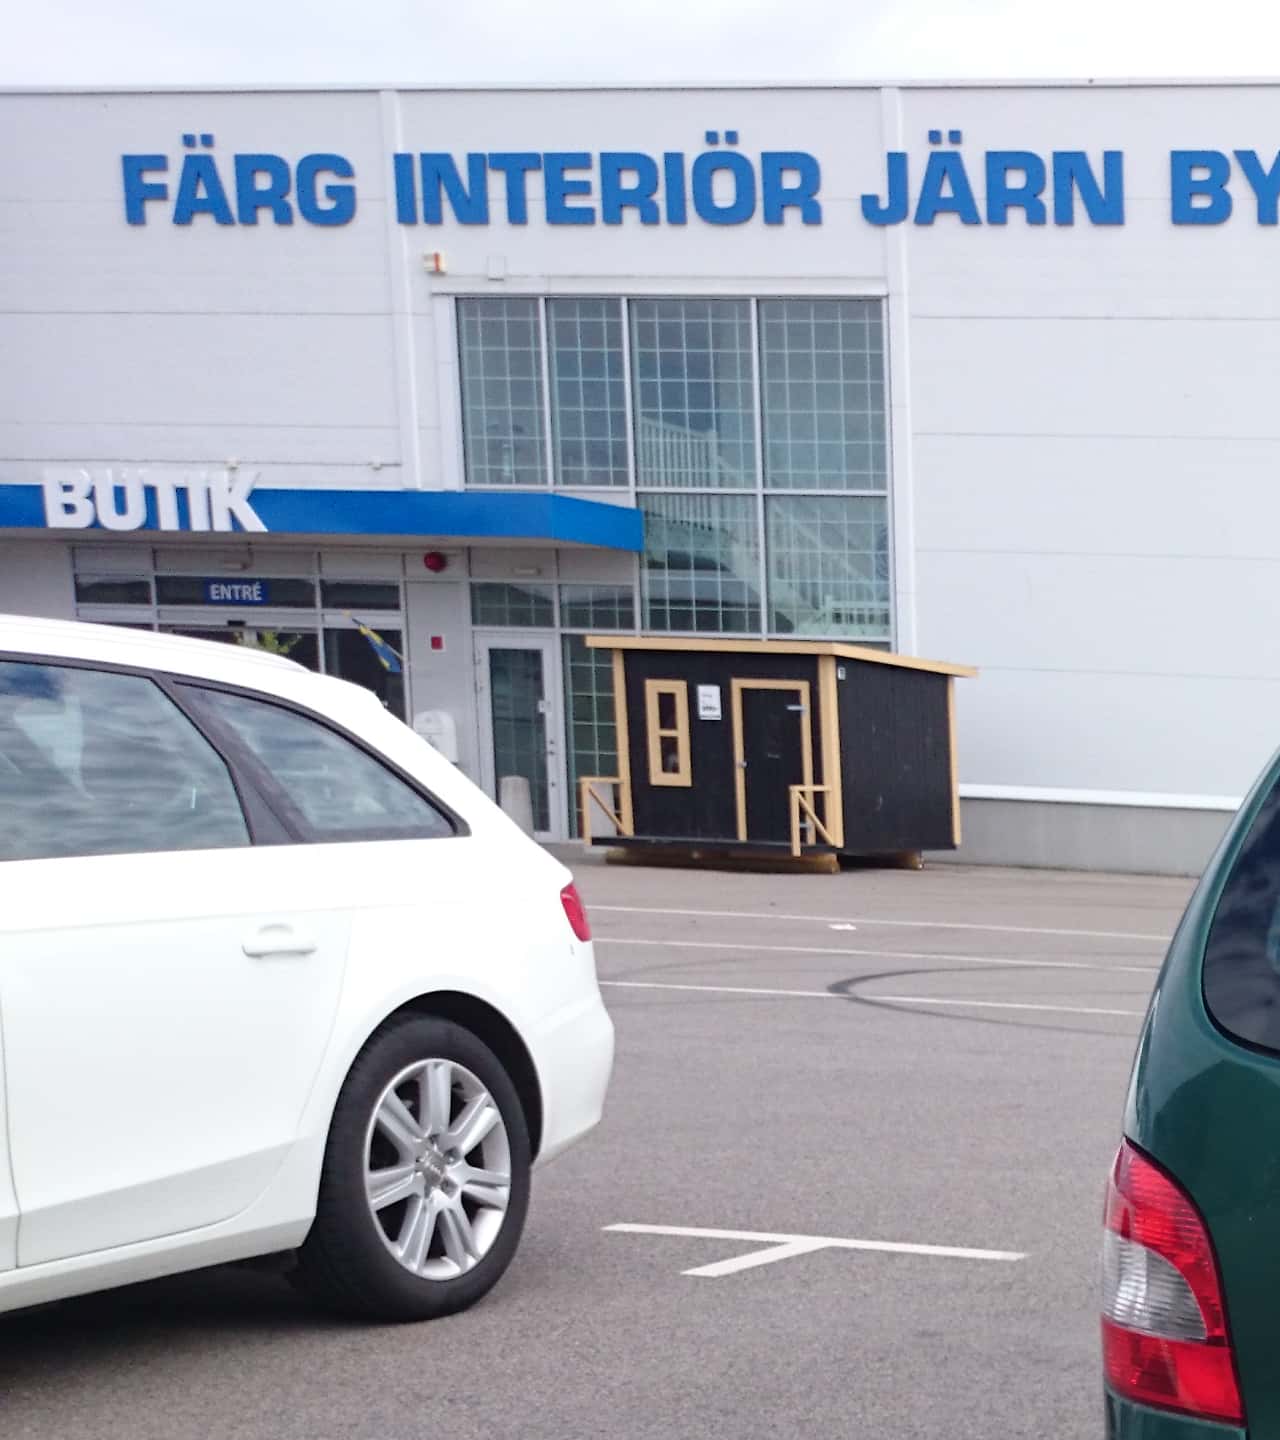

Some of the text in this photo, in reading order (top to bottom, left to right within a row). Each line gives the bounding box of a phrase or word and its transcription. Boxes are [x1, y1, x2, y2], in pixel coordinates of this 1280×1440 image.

[122, 134, 356, 226] FÄRG
[394, 131, 820, 226] INTERIÖR
[861, 130, 1124, 225] JÄRN
[42, 469, 269, 532] BUTIK
[210, 581, 262, 601] ENTRÉ
